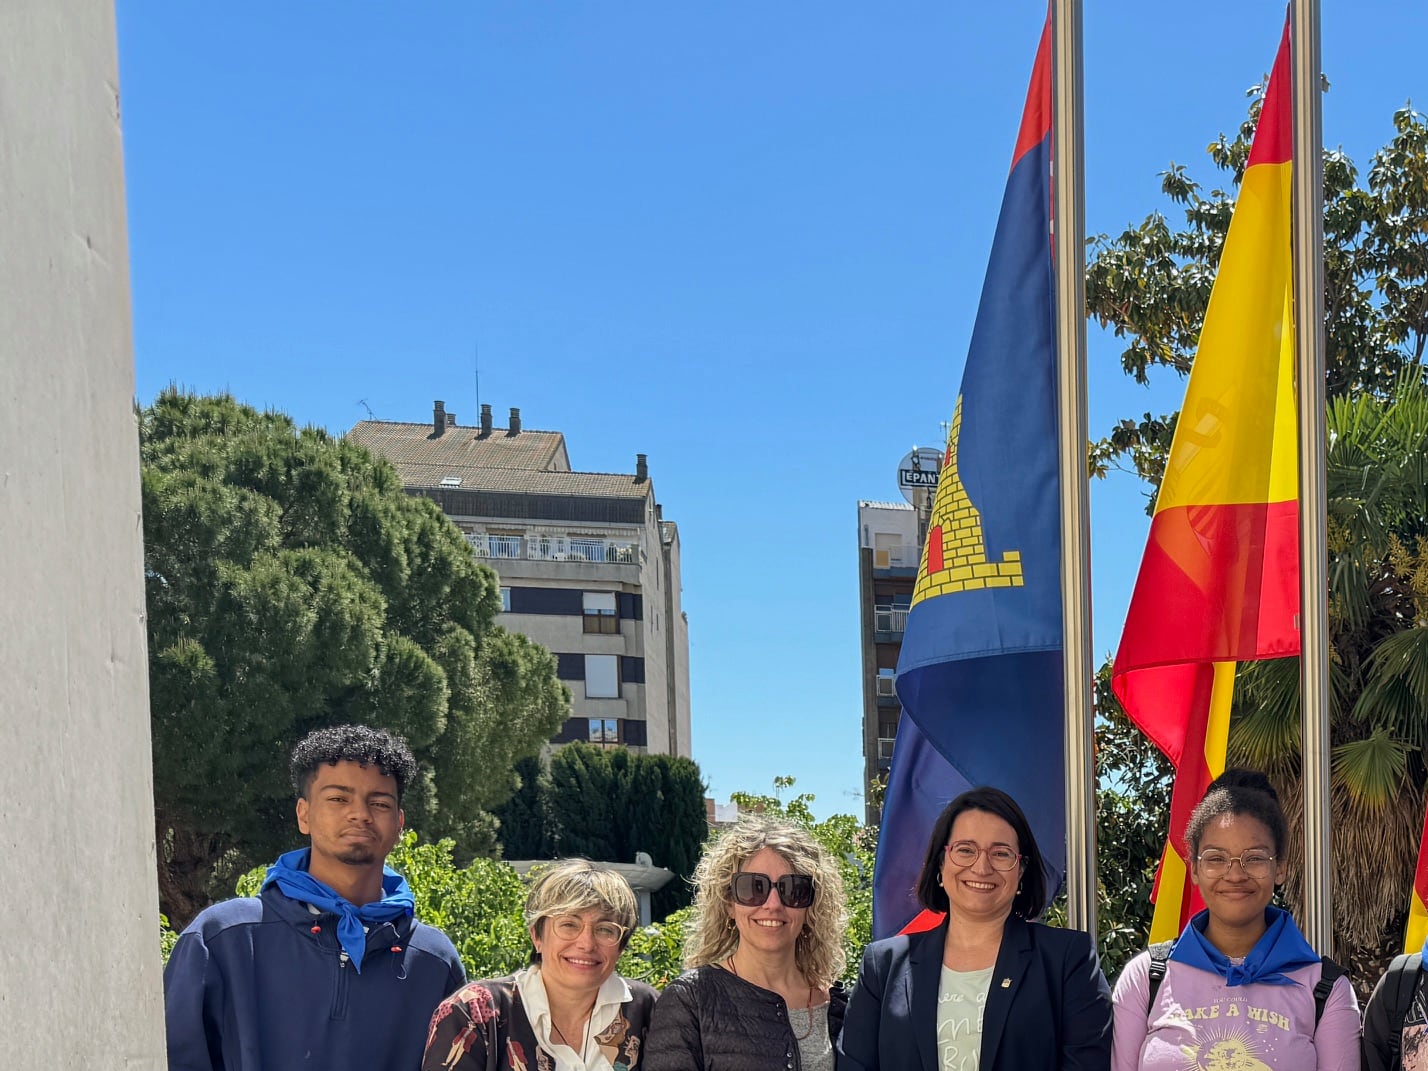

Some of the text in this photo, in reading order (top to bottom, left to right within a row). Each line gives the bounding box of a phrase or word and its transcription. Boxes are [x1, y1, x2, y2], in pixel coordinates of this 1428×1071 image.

[901, 470, 939, 485] LEPAN
[1226, 1003, 1240, 1017] A
[1247, 1005, 1290, 1032] WISH
